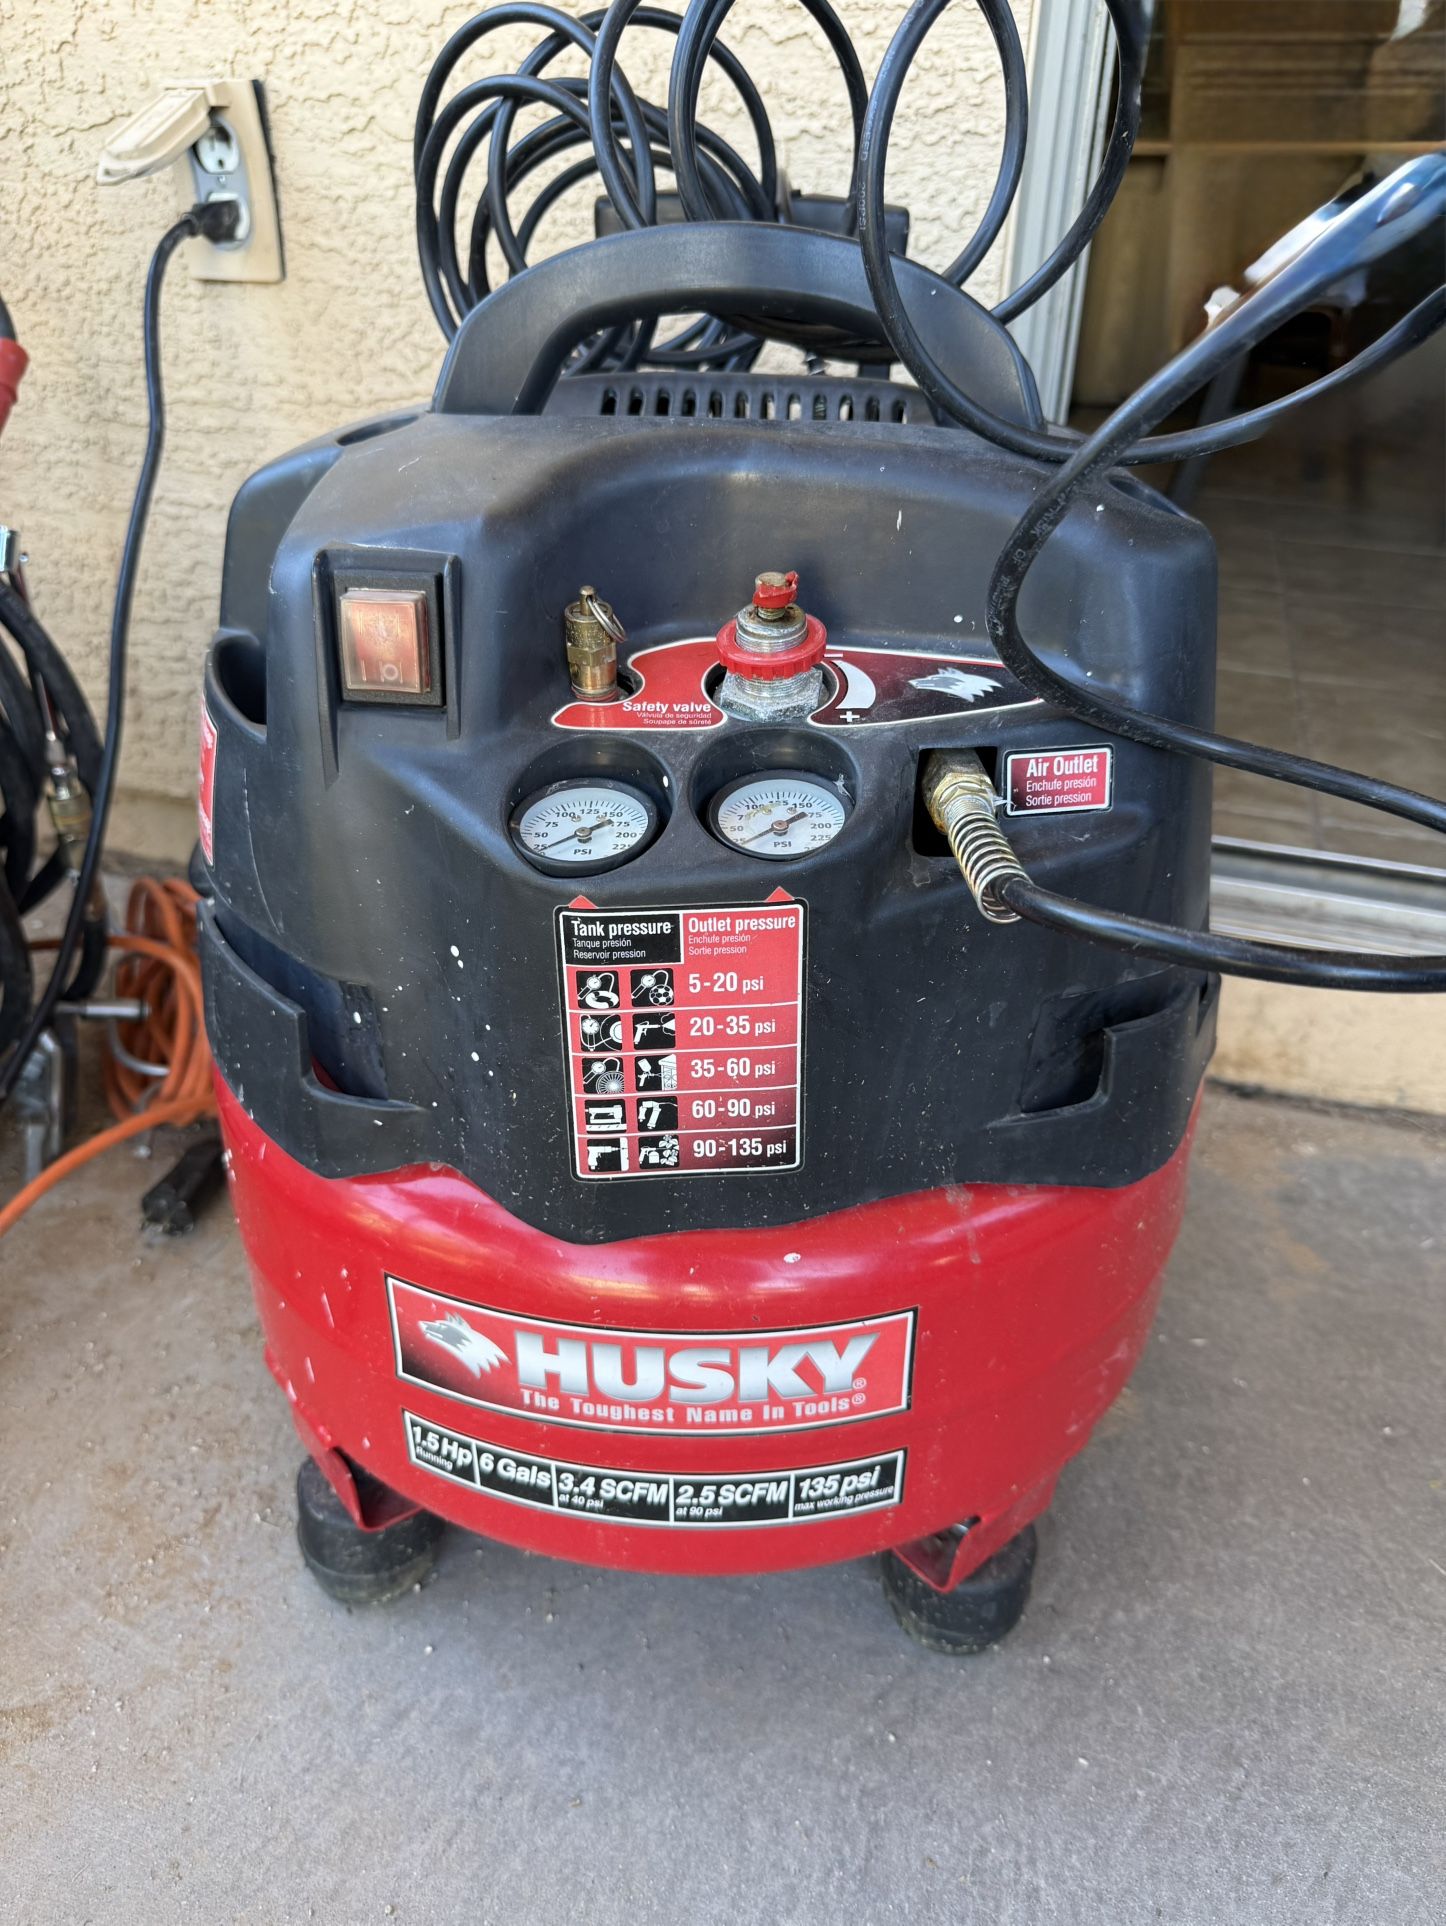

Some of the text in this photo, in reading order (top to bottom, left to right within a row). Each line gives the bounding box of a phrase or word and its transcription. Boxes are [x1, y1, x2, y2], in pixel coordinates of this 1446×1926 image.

[622, 701, 711, 713] Safety valve
[1026, 755, 1099, 777] Air Outlet
[1026, 776, 1097, 792] Enchufe presión
[1026, 792, 1092, 806] Sortie pression
[571, 918, 672, 939] Tank pressure
[688, 915, 796, 934] Outlet pressure
[573, 938, 632, 949] Tanque presión
[688, 933, 751, 944] Enchufe presión
[573, 948, 646, 960] Reservoir pression
[688, 945, 747, 956] Sortie pression
[742, 975, 764, 994] psi
[689, 1016, 776, 1037] 20-35 psi
[690, 1057, 776, 1078] 35-60 psi
[692, 1099, 775, 1118] 60-90 psi
[693, 1138, 787, 1158] 90-135 psi
[519, 1389, 560, 1411] The
[569, 1397, 675, 1422] Toughest
[686, 1406, 752, 1423] Name
[763, 1404, 785, 1420] In
[412, 1426, 473, 1466] 1.5 Hp
[416, 1446, 454, 1471] Running
[479, 1452, 551, 1488] 6 Gals
[559, 1472, 669, 1505] 3.4 SCFM
[799, 1465, 882, 1499] 135 psi
[559, 1493, 604, 1510] at 40 psi
[676, 1481, 789, 1506] 2.5 SCFM
[794, 1486, 895, 1512] max working pressure
[676, 1506, 723, 1518] at 90 psi
